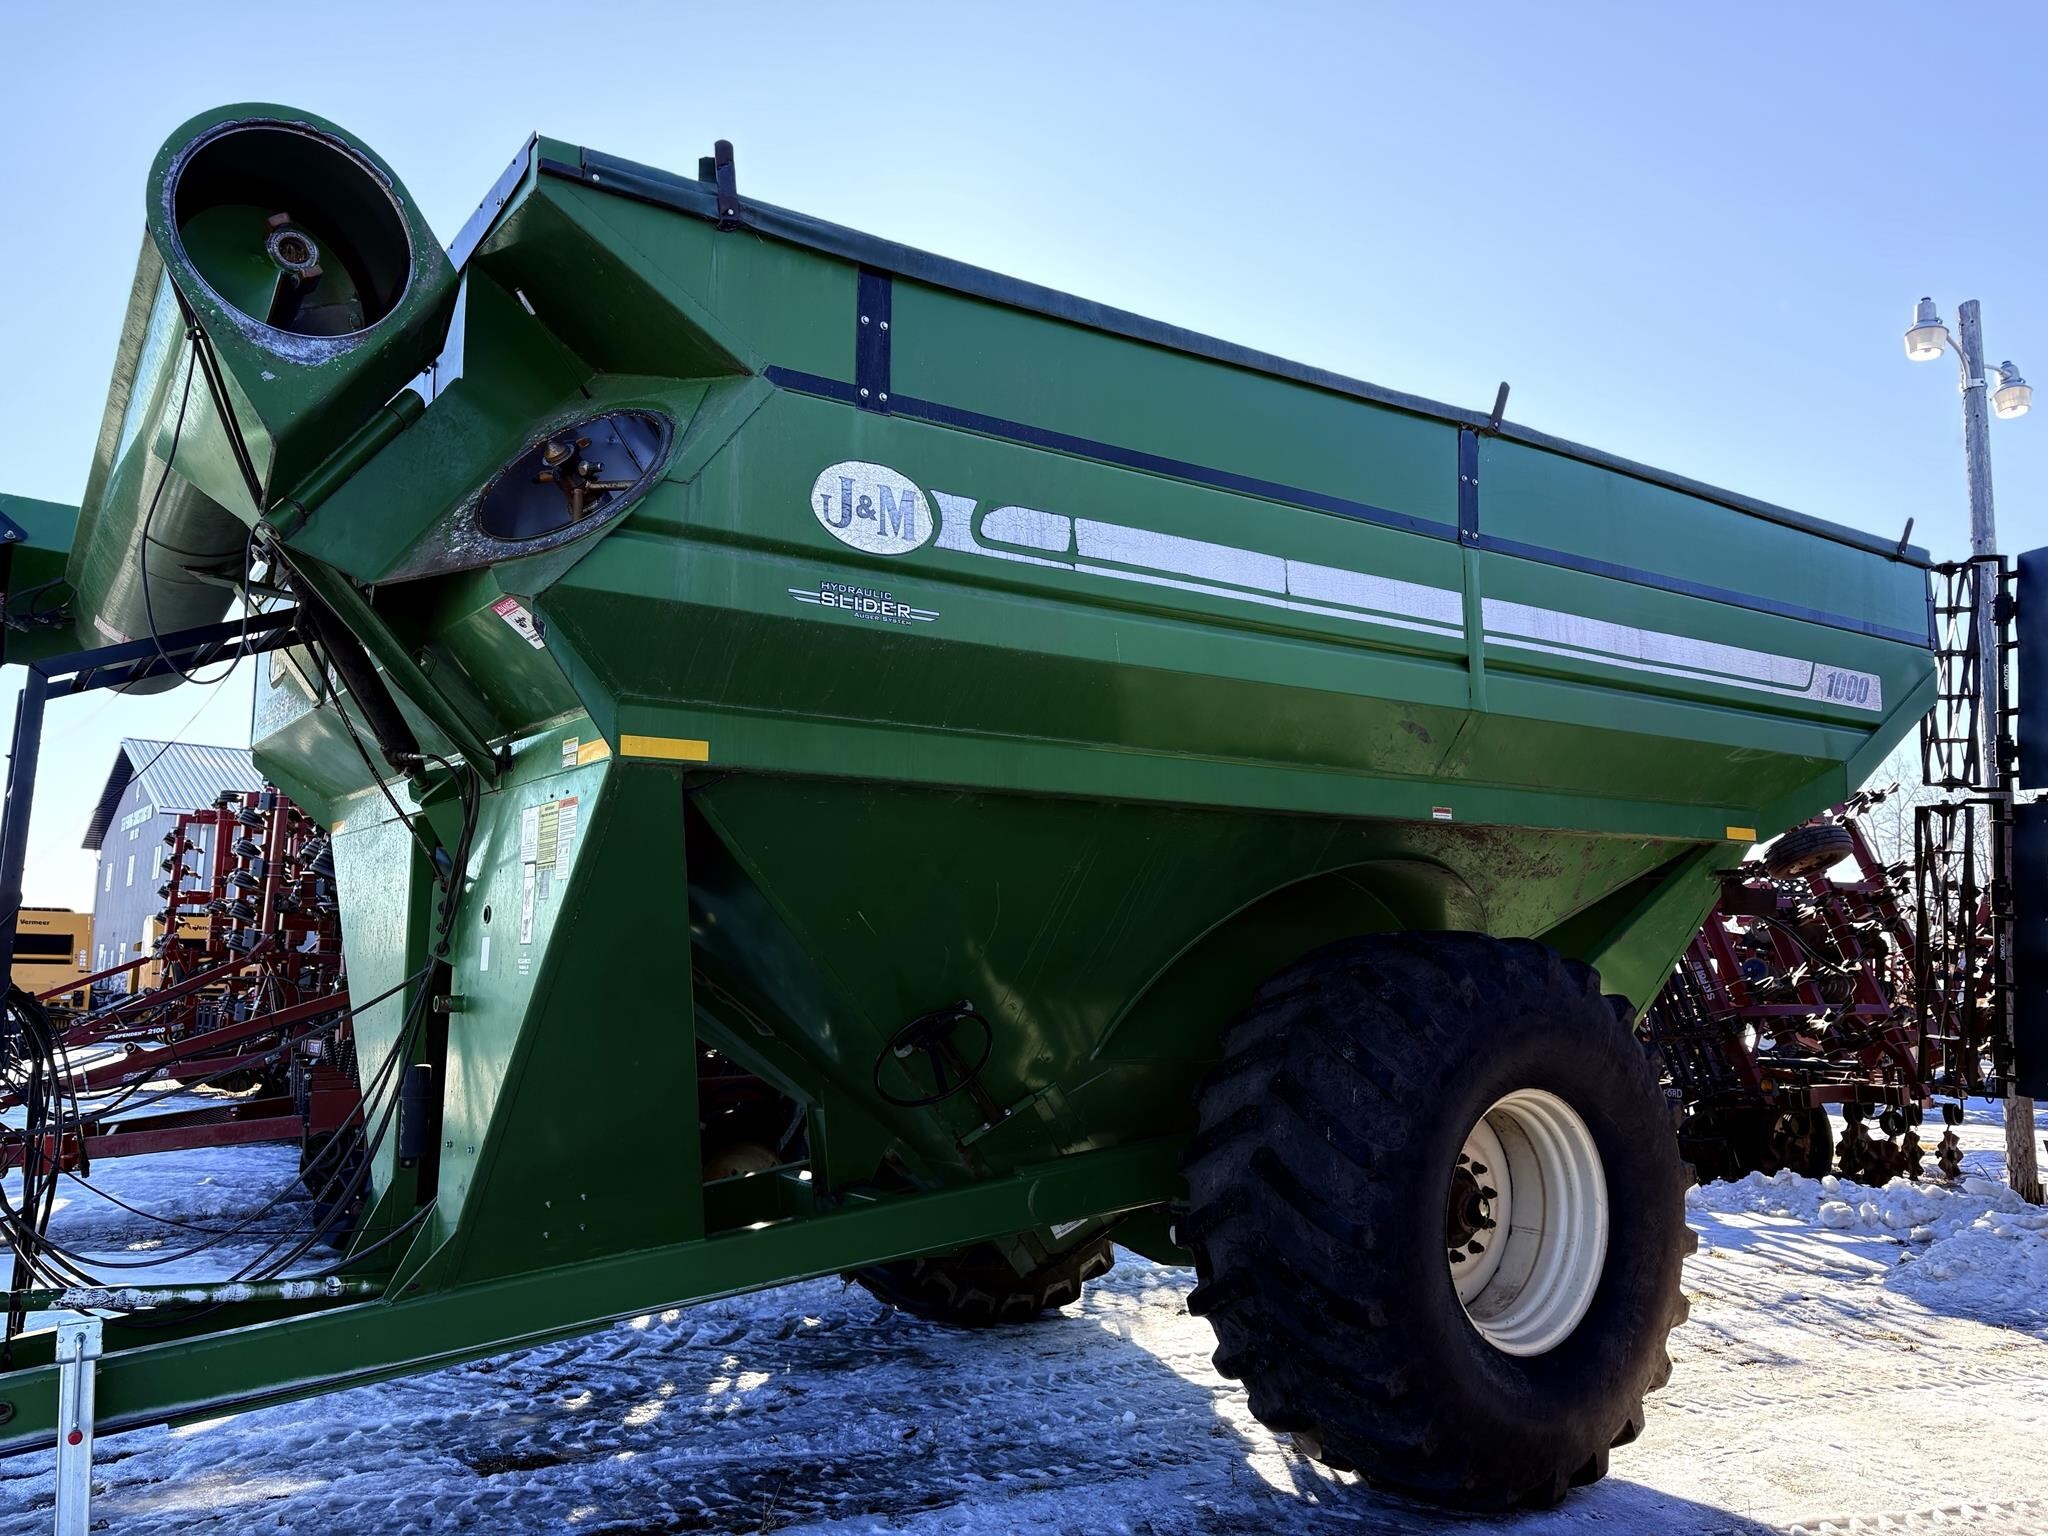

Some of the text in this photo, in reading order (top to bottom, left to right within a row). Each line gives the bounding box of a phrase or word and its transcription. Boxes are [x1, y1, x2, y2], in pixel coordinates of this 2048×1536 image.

[821, 476, 916, 542] J&M
[821, 581, 893, 600] HYDRAULIC
[820, 591, 912, 619] SLIDER
[1826, 671, 1870, 704] 1000
[147, 1027, 166, 1035] 2100
